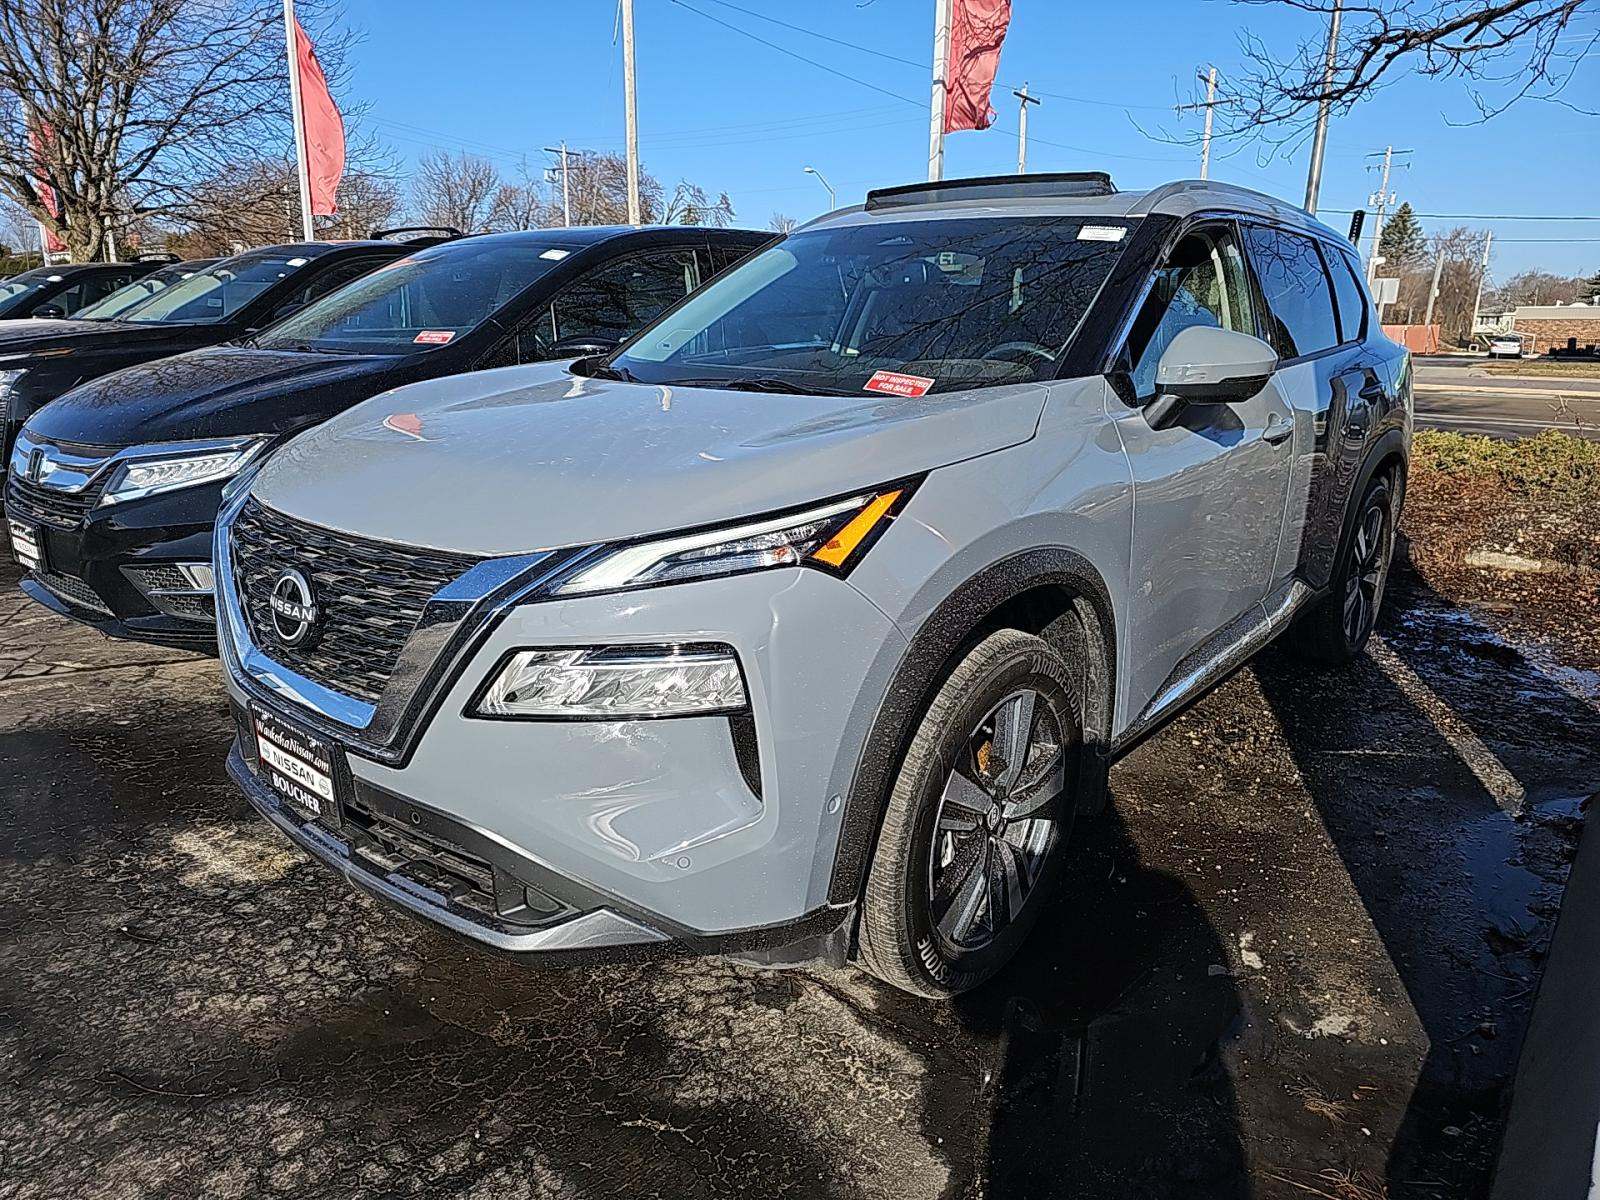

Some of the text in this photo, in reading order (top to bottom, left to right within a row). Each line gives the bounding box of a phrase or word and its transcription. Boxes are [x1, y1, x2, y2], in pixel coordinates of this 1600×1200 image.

[873, 374, 929, 387] NOT INSPECTED
[878, 382, 914, 394] FOR SALE
[270, 595, 313, 621] NISSAN
[255, 718, 330, 773] WaukeshaNissan.com
[272, 750, 315, 787] NISSAN
[272, 771, 321, 815] BOUCHER
